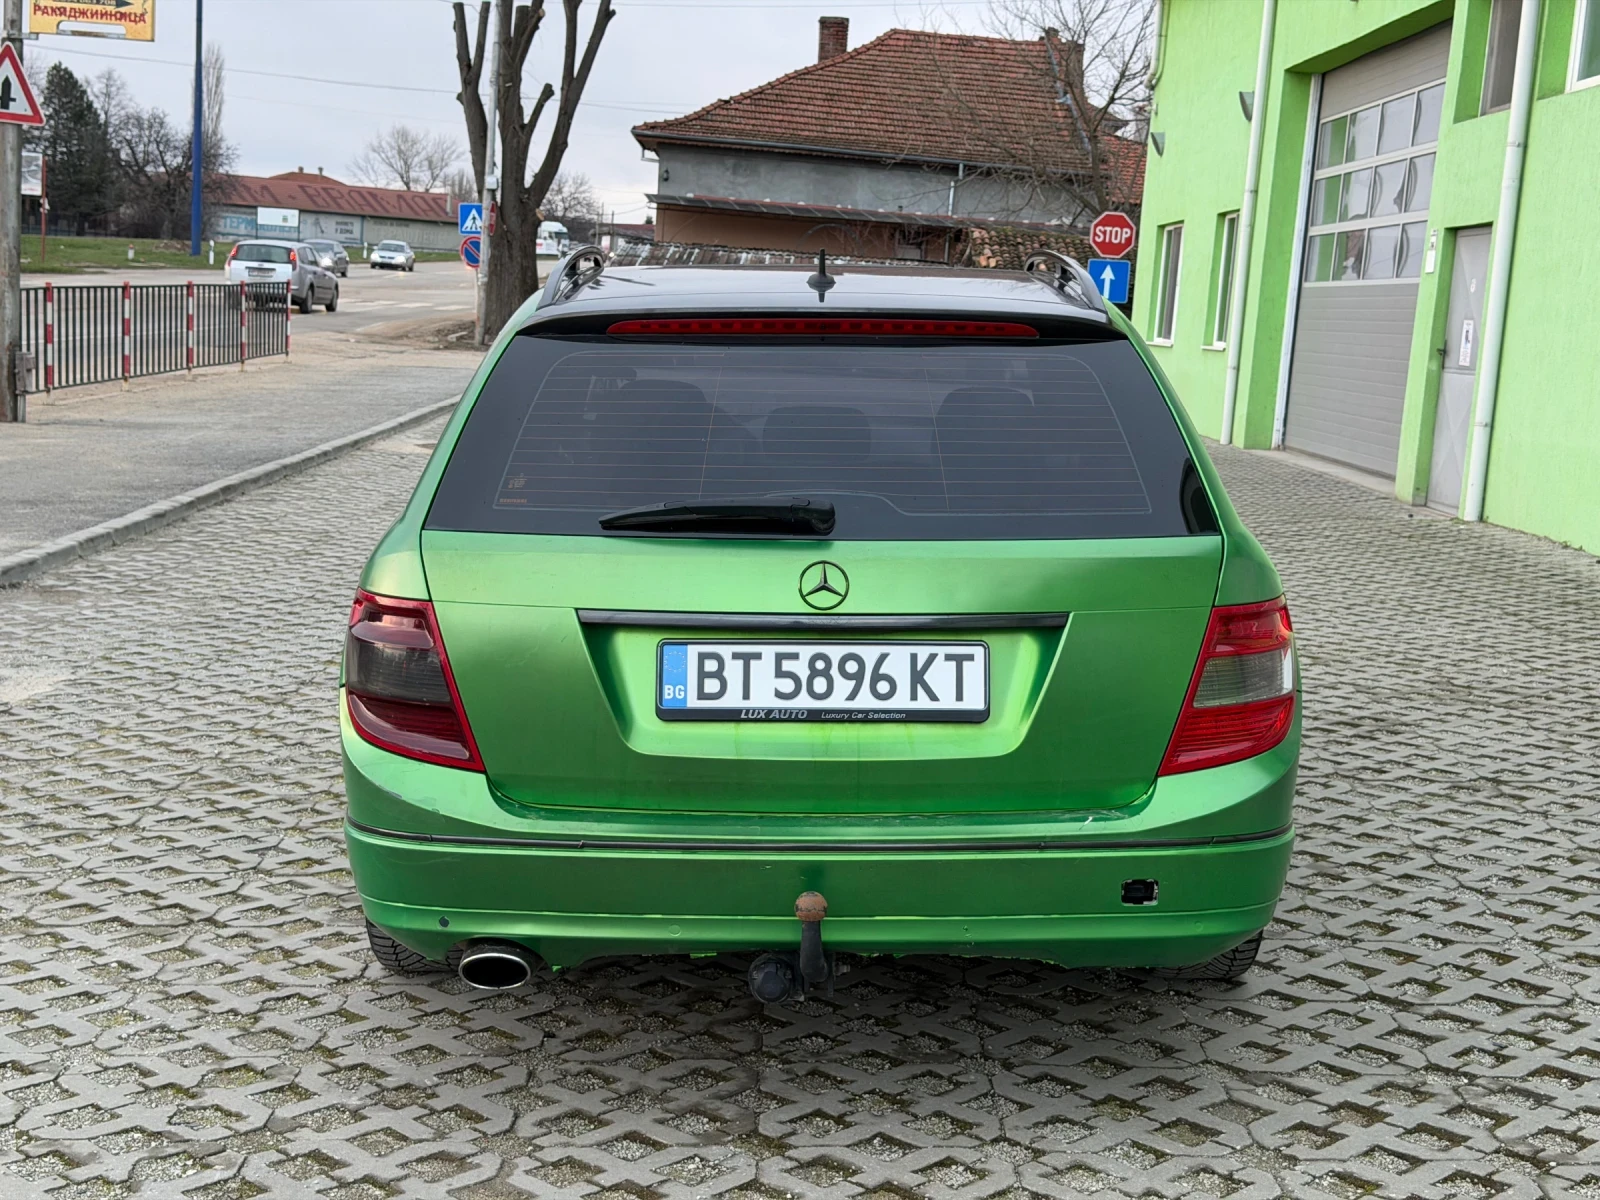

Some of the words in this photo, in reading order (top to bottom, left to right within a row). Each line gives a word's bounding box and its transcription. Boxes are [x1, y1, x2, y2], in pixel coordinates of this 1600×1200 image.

[1094, 225, 1131, 245] STOP
[696, 651, 763, 701] BT
[773, 651, 898, 702] 5896
[909, 652, 976, 702] KT
[664, 685, 685, 700] BG
[740, 709, 767, 719] LUX
[769, 709, 808, 719] AUTO
[821, 712, 850, 720] Luxury
[867, 712, 907, 720] Selection
